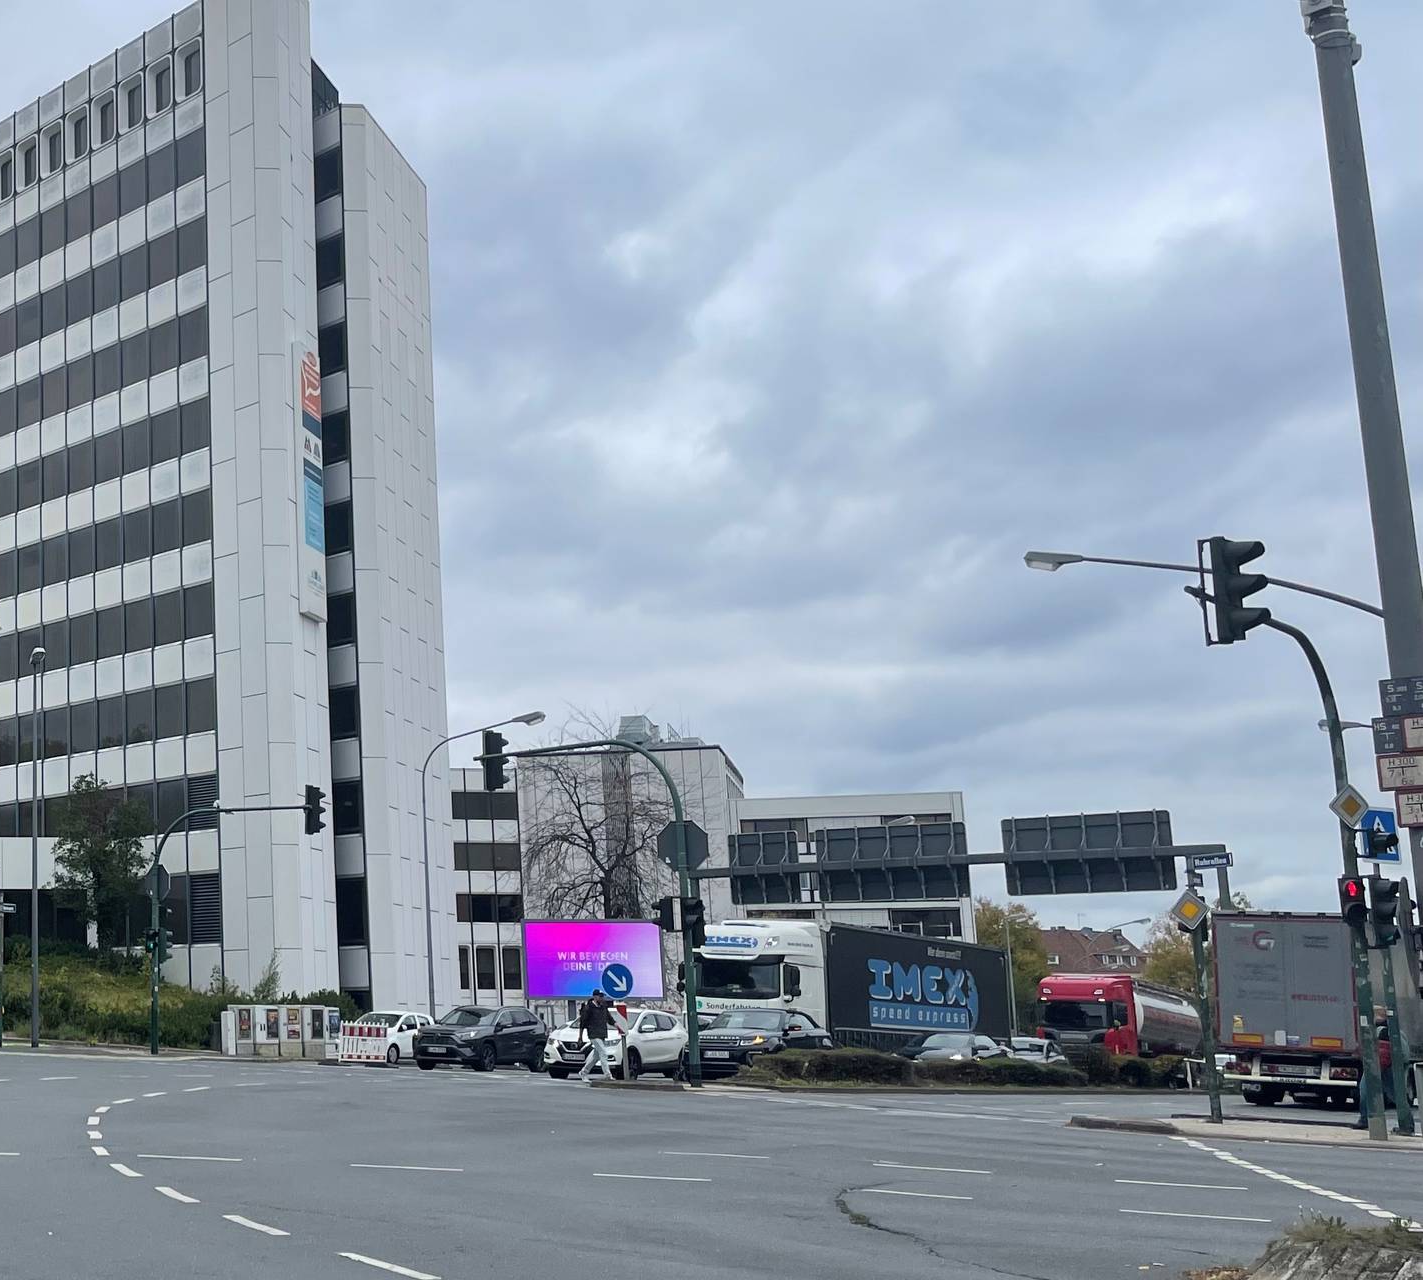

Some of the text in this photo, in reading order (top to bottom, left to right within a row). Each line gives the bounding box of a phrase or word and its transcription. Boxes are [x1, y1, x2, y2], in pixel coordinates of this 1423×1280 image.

[706, 935, 751, 944] IMEX
[557, 951, 628, 961] WIR BEWEGEN
[563, 962, 593, 971] DEINE
[868, 959, 967, 1006] IMEX
[872, 1006, 967, 1024] speed express
